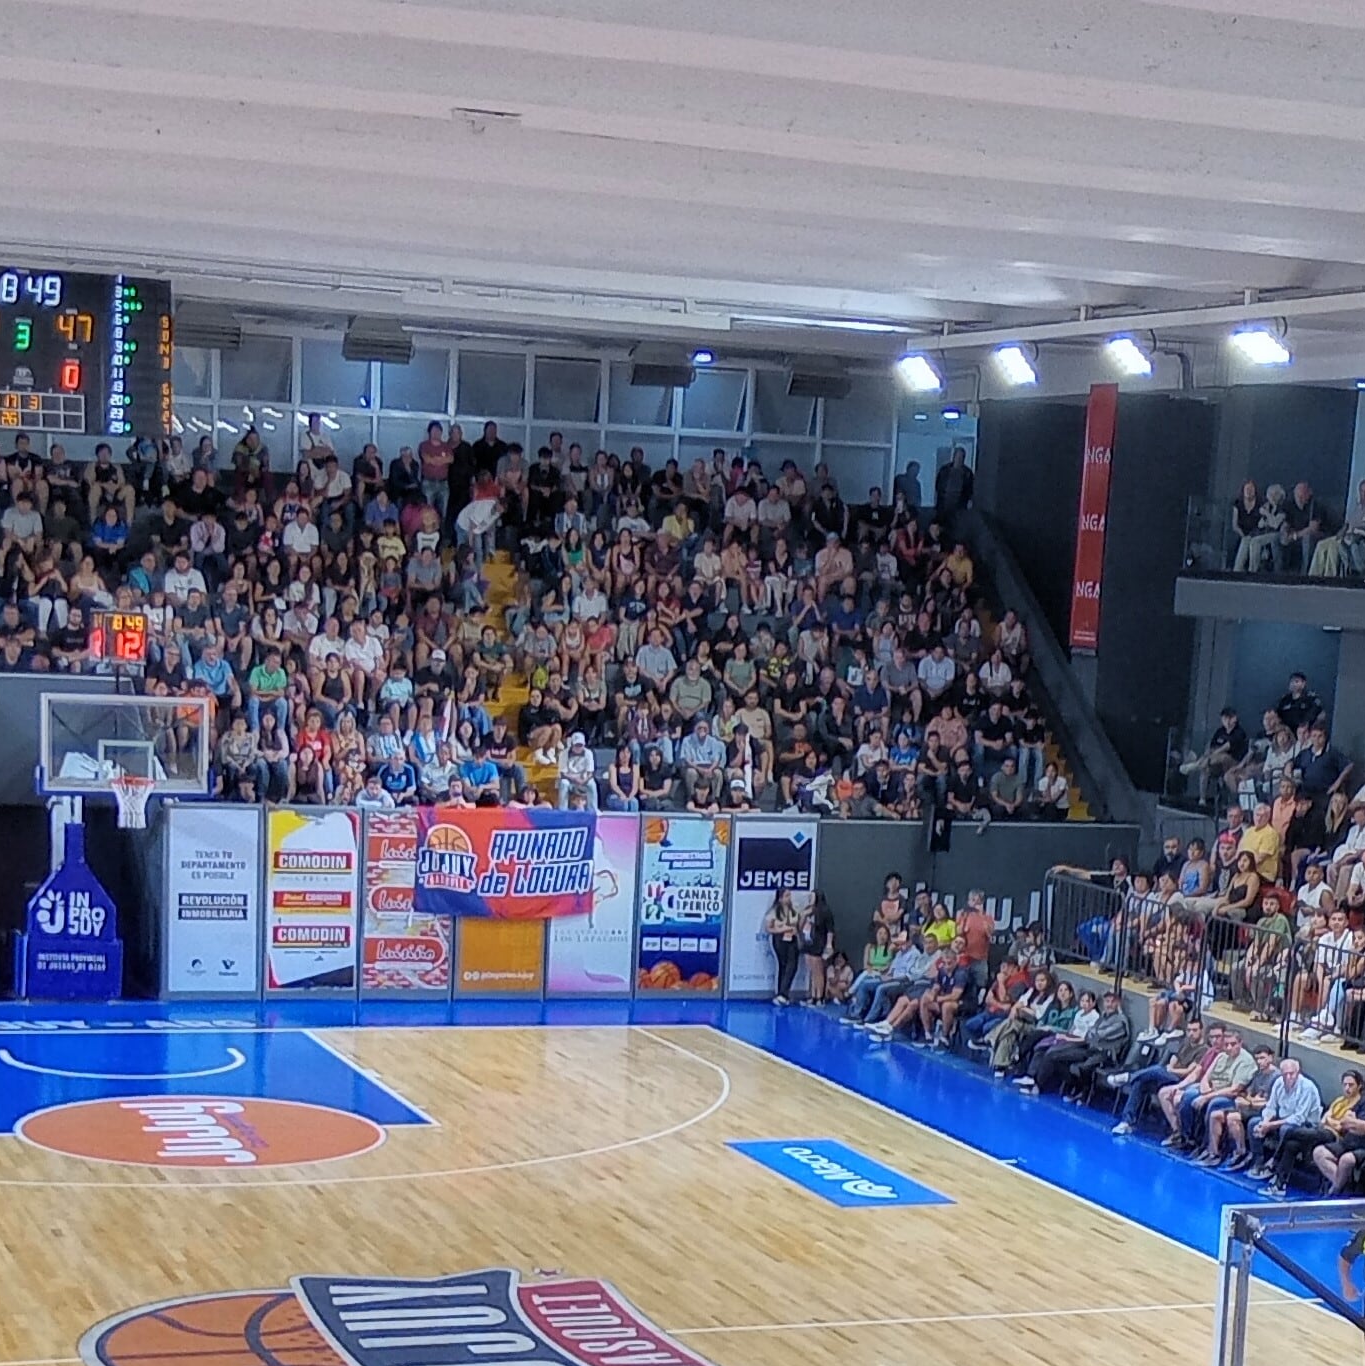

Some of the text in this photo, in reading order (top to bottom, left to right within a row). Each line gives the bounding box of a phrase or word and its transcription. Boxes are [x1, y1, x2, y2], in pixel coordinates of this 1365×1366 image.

[58, 315, 92, 342] 47
[16, 324, 30, 349] 3
[65, 365, 80, 389] 0
[5, 394, 17, 407] 17
[29, 395, 38, 409] 3
[2, 412, 18, 425] 26
[117, 631, 141, 660] 12
[490, 827, 587, 863] APUNADO
[181, 861, 246, 869] DEPARTAMENTO
[279, 855, 347, 869] COMODIN
[421, 850, 472, 878] JUJUY
[480, 868, 509, 896] de
[513, 860, 593, 896] LOCURA
[740, 870, 808, 887] JEMSE
[69, 891, 89, 907] IN
[181, 894, 244, 905] REVOLUCIÓN
[678, 889, 711, 899] CANAL
[181, 909, 244, 918] INMOBILIARIA
[683, 901, 719, 911] PERICO
[69, 907, 105, 921] PRO
[277, 928, 346, 942] COMODIN
[782, 1146, 862, 1180] Macro
